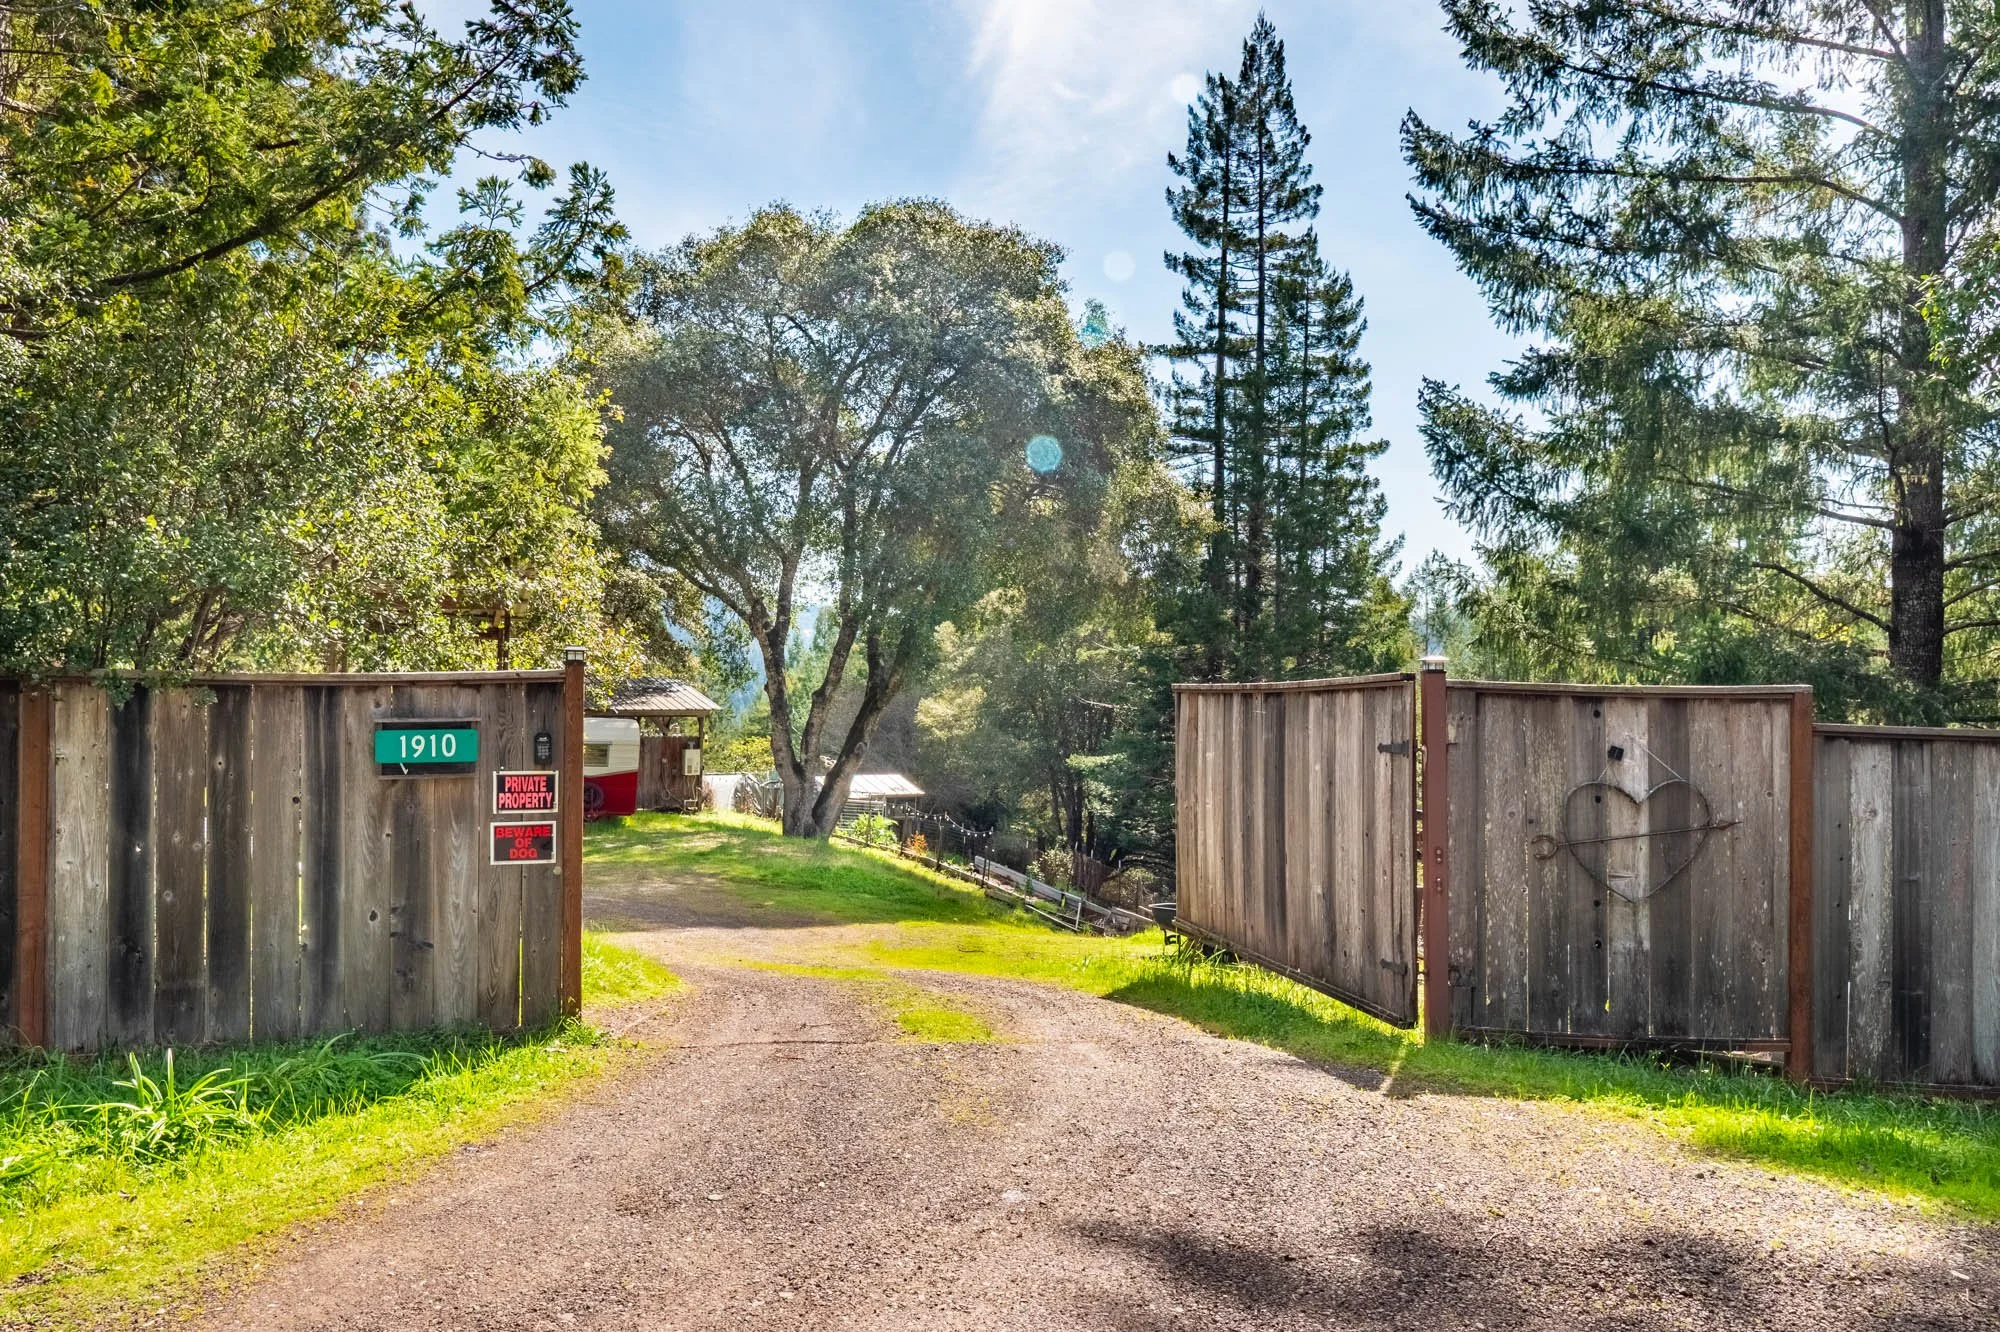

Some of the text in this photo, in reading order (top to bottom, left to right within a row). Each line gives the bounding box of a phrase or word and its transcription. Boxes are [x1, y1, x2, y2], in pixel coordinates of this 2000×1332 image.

[400, 733, 456, 758] 1910
[505, 776, 547, 792] PRIVATE
[498, 792, 553, 808] PROPERTY
[495, 826, 552, 838] BEWARE
[515, 838, 532, 848] OF
[509, 848, 538, 859] DOG
